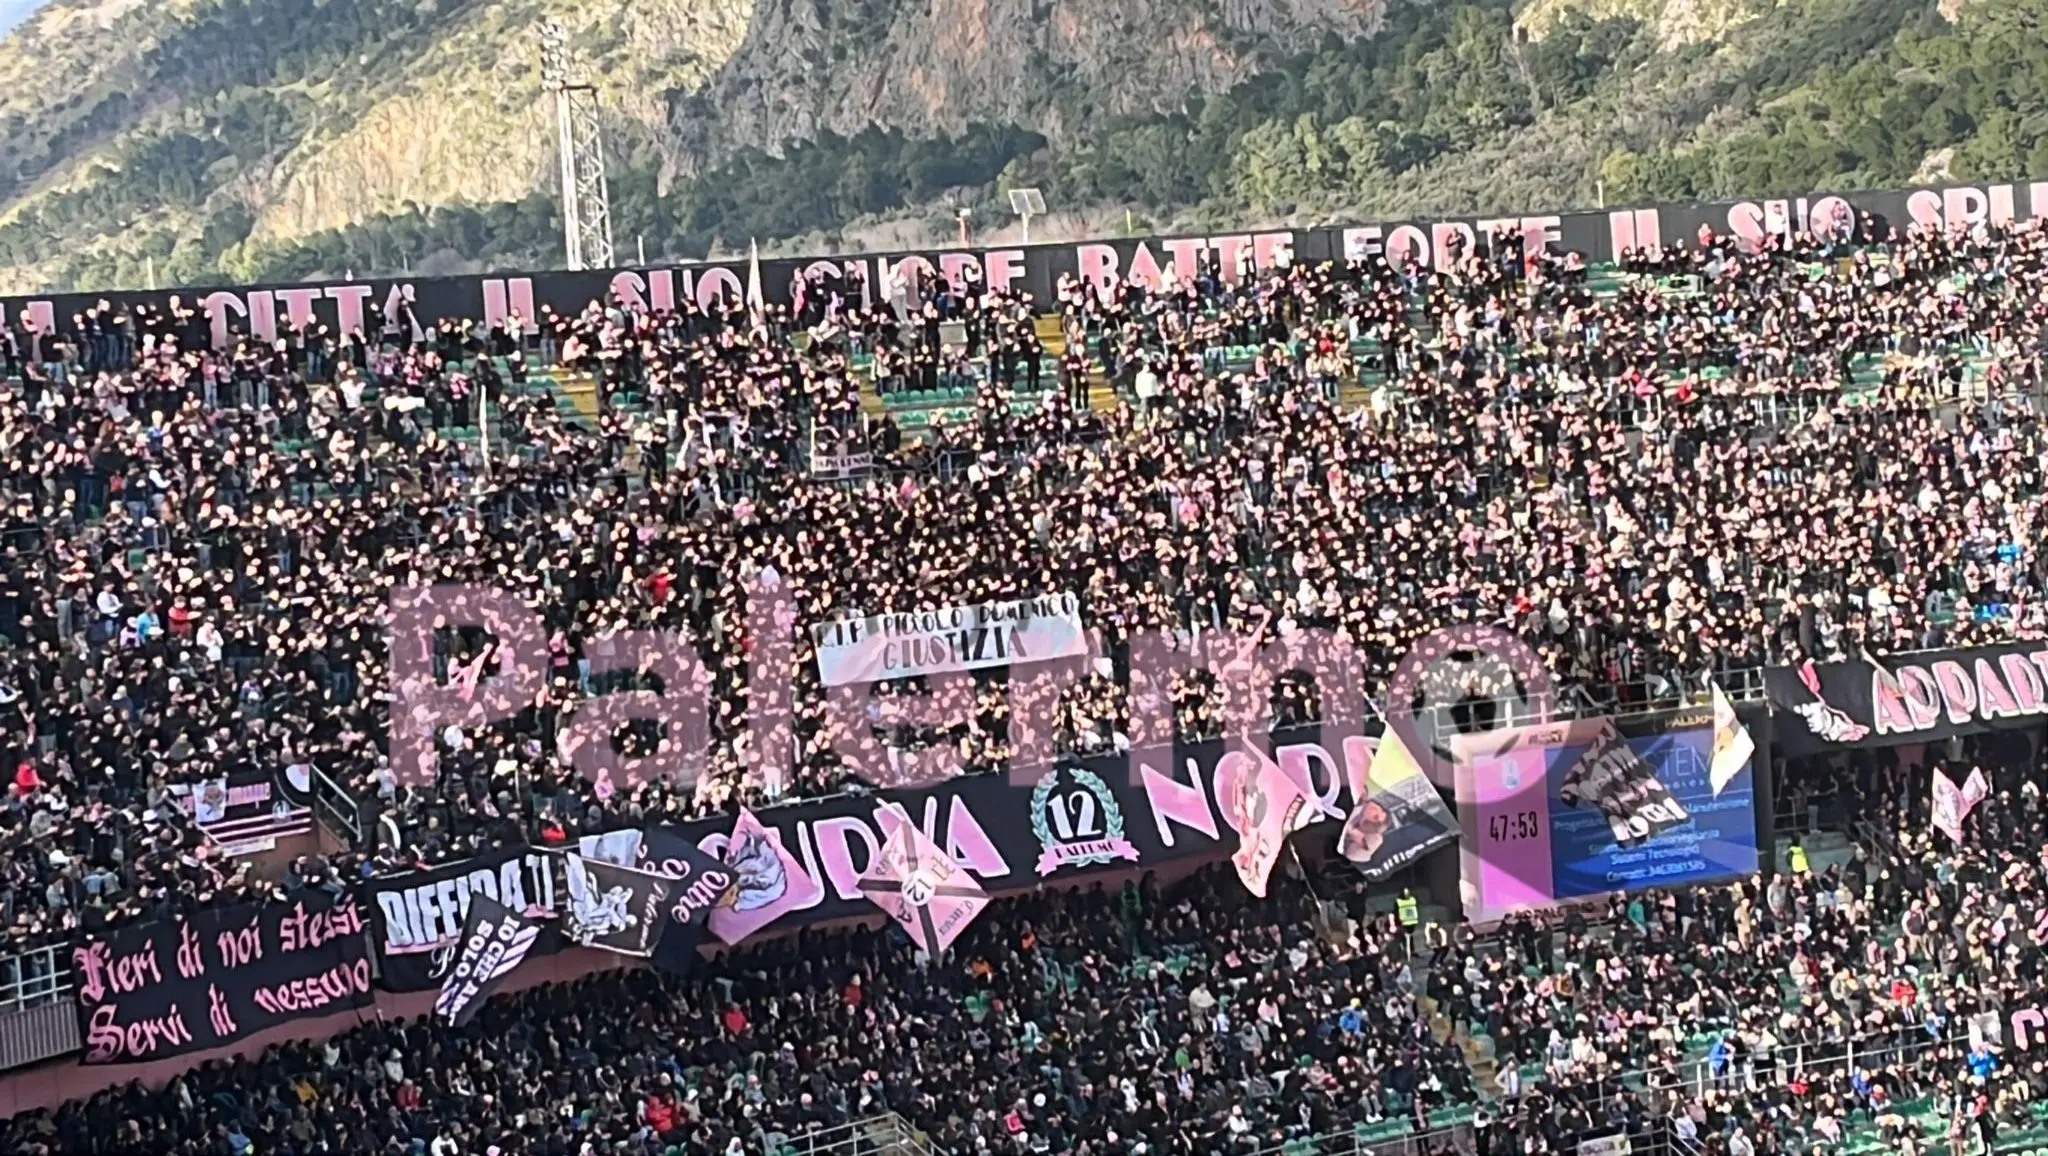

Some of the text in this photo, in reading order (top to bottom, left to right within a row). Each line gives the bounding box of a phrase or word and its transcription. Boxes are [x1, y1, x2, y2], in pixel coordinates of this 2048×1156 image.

[1077, 232, 1294, 304] BATTE
[1343, 215, 1562, 276] FORTE
[883, 606, 965, 637] PICCOLO
[882, 624, 1028, 671] GIUSTIZIA
[1047, 790, 1102, 840] 12
[1489, 810, 1539, 843] 47:53
[376, 853, 555, 946] DIFFIDATI
[671, 871, 730, 923] Oltre
[177, 922, 205, 979] di
[217, 916, 263, 968] noi
[279, 893, 364, 952] stessi
[455, 919, 494, 978] SOLO
[497, 915, 521, 941] IO
[472, 941, 505, 983] CHE
[84, 1003, 193, 1064] Servi
[209, 983, 237, 1037] di
